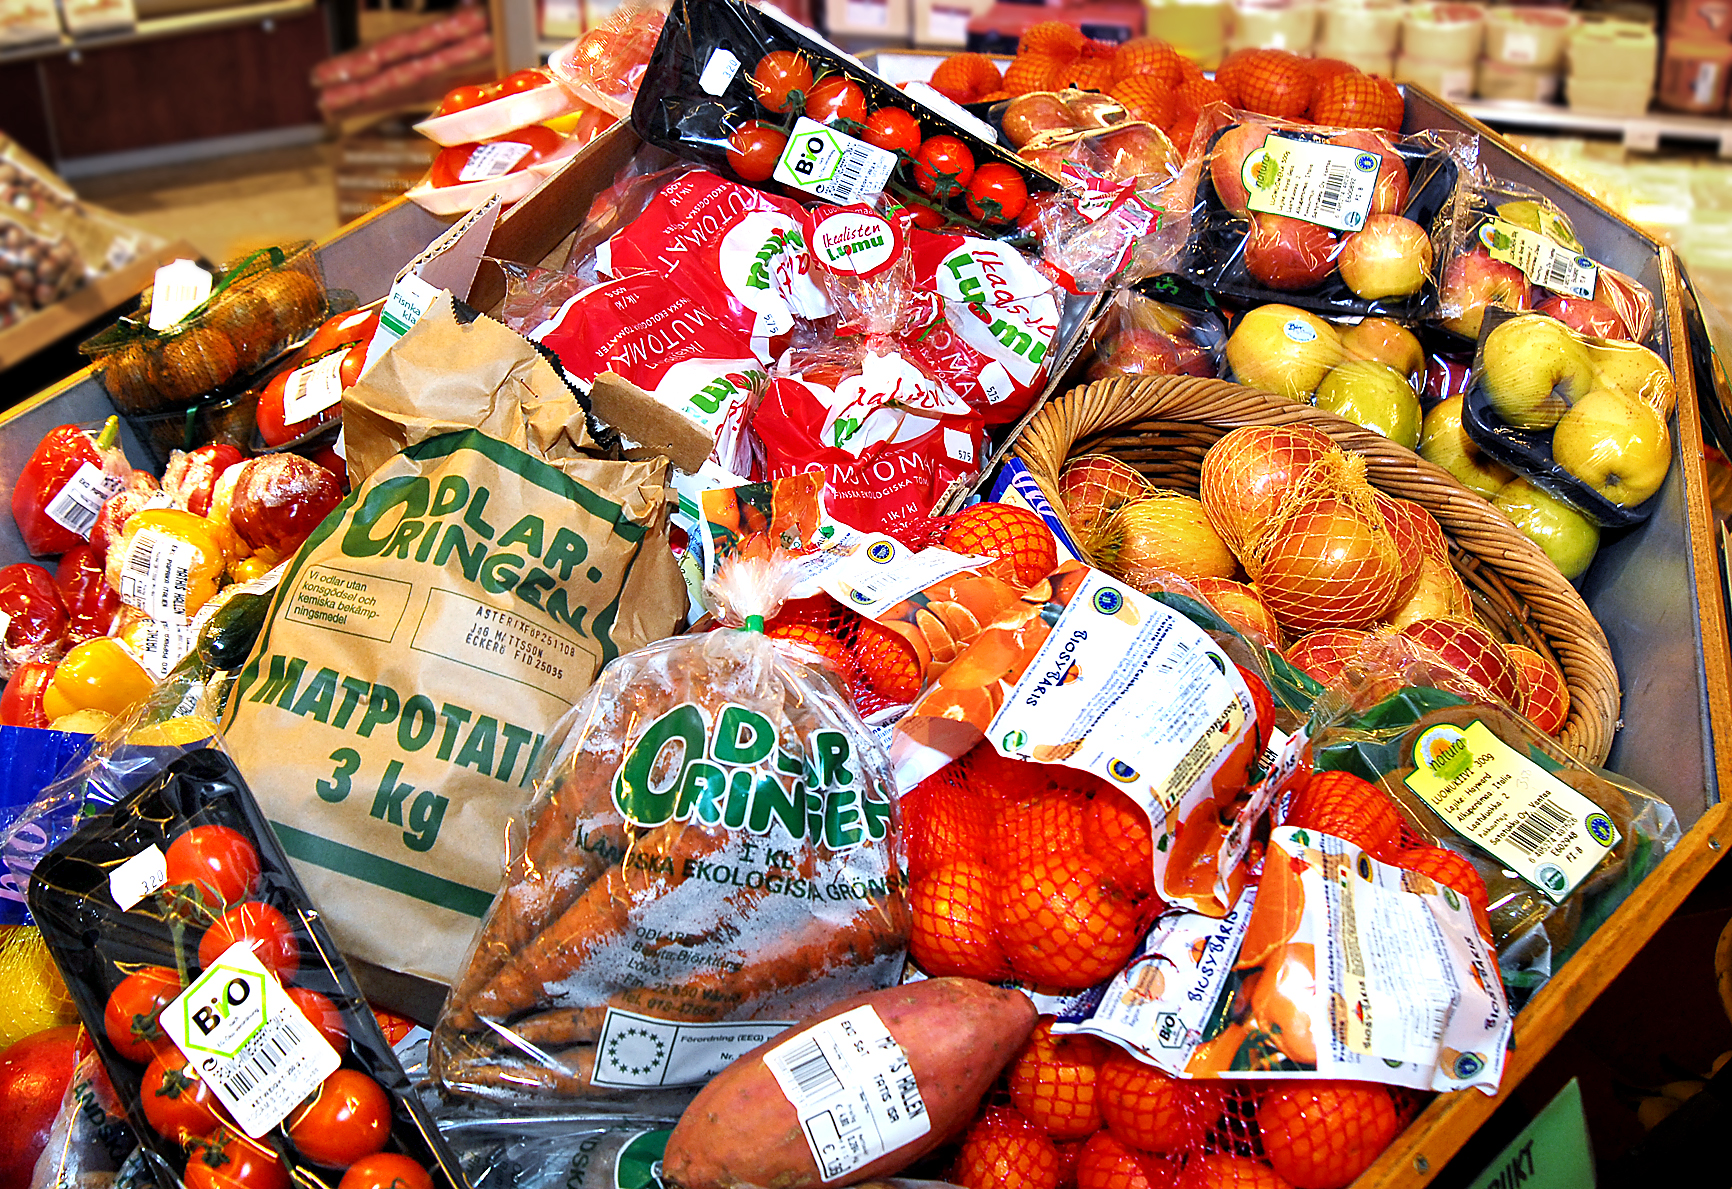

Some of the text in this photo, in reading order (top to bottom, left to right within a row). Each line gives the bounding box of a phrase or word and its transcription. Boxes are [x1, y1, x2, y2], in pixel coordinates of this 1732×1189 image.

[1252, 153, 1271, 187] natura
[309, 571, 367, 592] Vi odlar utan
[298, 592, 335, 609] kemiska
[358, 593, 377, 607] och
[294, 605, 347, 625] ningsmedel
[534, 658, 563, 679] 25035
[1425, 733, 1467, 774] natura
[1430, 749, 1496, 807] LUOMUKIIVI 300g
[1463, 769, 1493, 798] Hayward
[1491, 770, 1512, 791] Italia
[316, 747, 449, 851] 3 kg
[1500, 790, 1510, 801] 2
[1489, 816, 1521, 847] Satotukku
[1527, 787, 1552, 811] Vantaa
[737, 1033, 764, 1043] (EEG)
[891, 1074, 929, 1120] HALLEN
